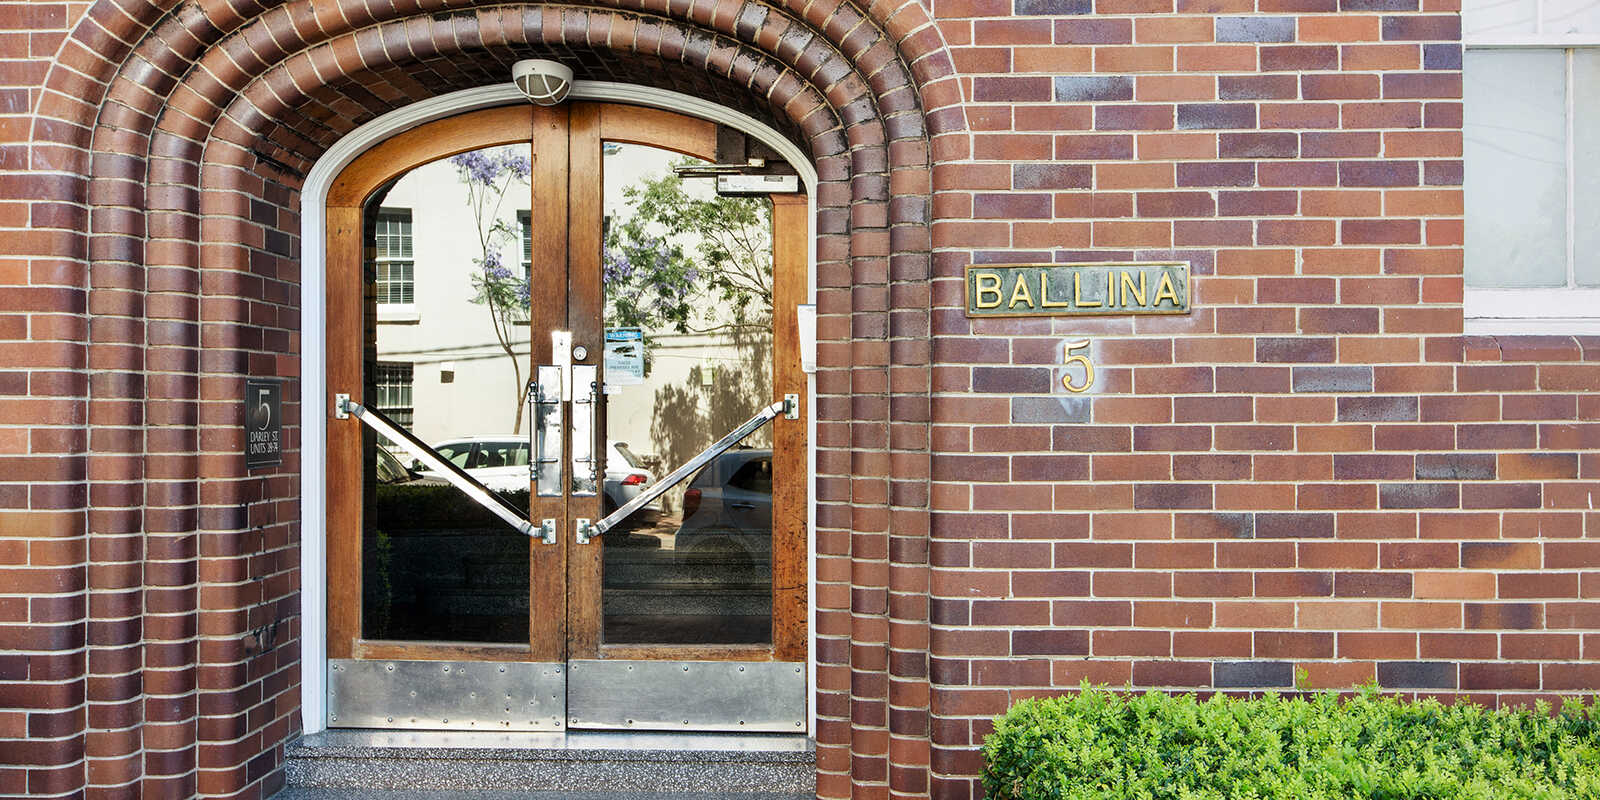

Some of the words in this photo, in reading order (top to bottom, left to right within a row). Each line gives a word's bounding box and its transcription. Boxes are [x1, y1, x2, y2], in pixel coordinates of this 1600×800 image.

[975, 271, 1180, 309] BALLINA
[1063, 339, 1095, 392] 5
[258, 389, 271, 431] 5
[250, 431, 271, 443] DARLEY
[250, 442, 266, 455] UNITS
